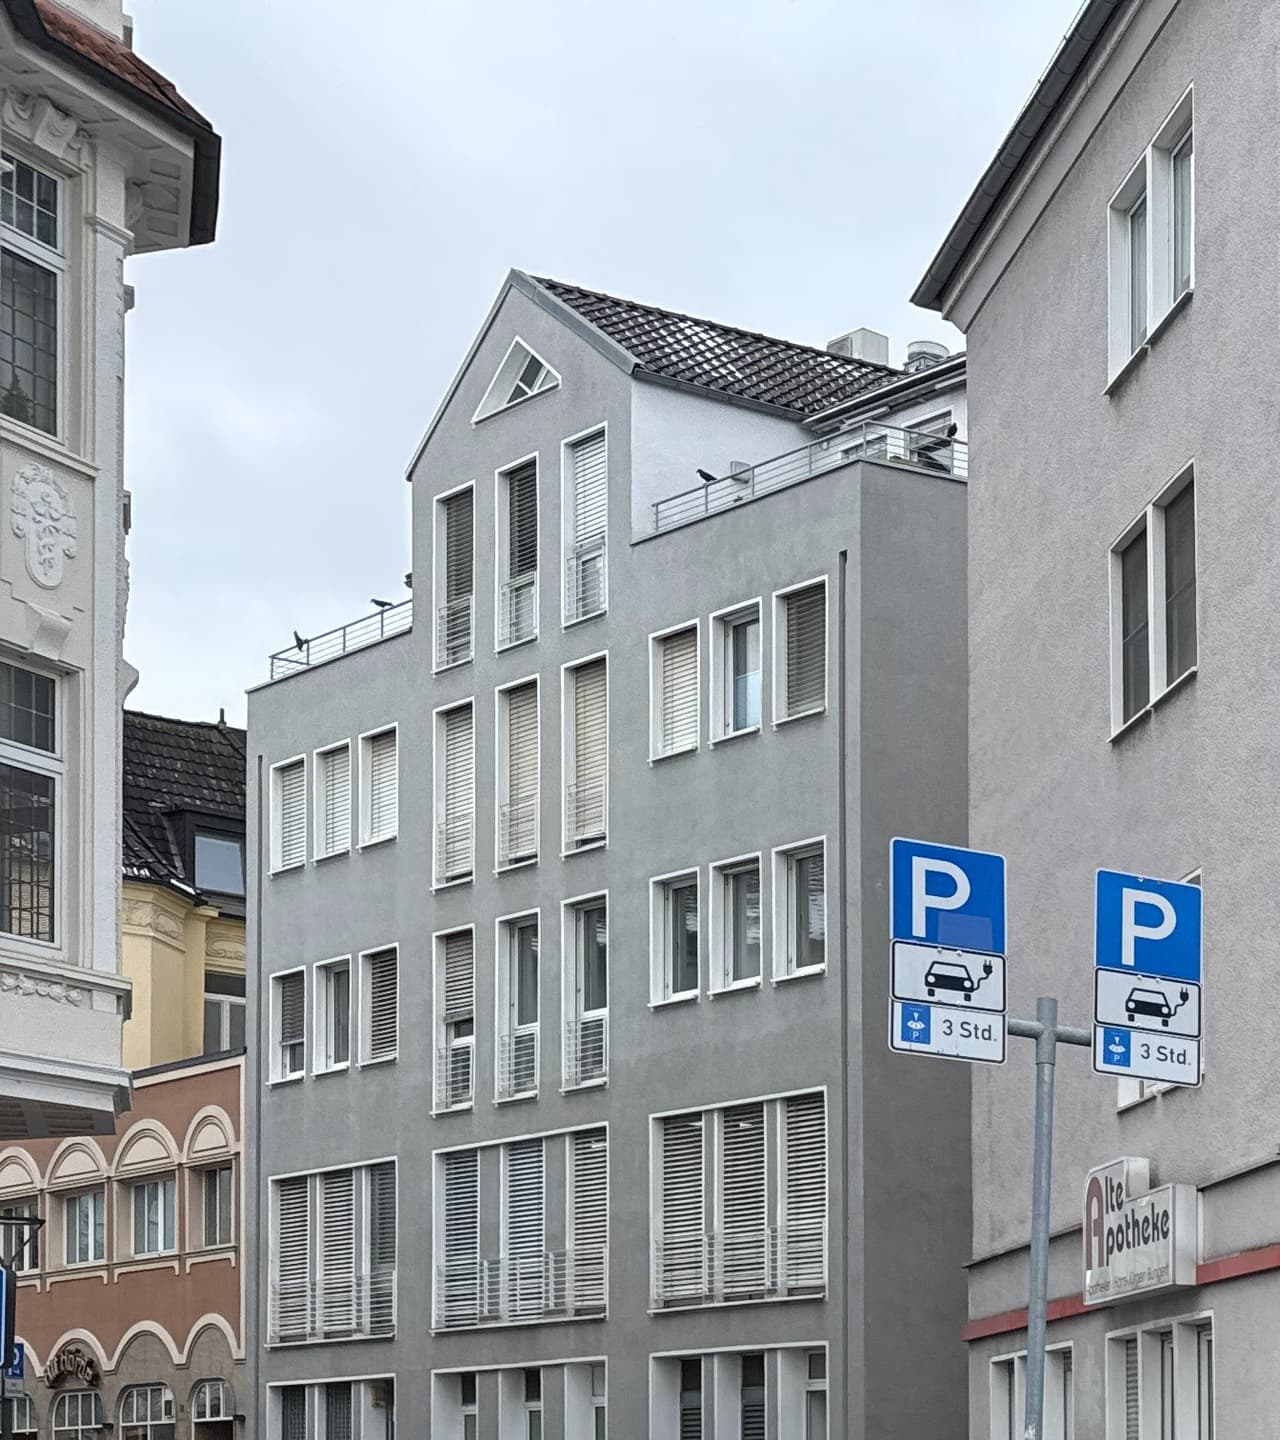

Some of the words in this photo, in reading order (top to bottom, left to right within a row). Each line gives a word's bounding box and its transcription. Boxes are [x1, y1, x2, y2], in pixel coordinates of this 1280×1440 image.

[912, 856, 971, 938] P
[1122, 887, 1177, 967] P
[942, 1019, 953, 1037] 3
[959, 1021, 998, 1042] Std.
[1140, 1044, 1150, 1060] 3
[1156, 1046, 1192, 1066] Std.
